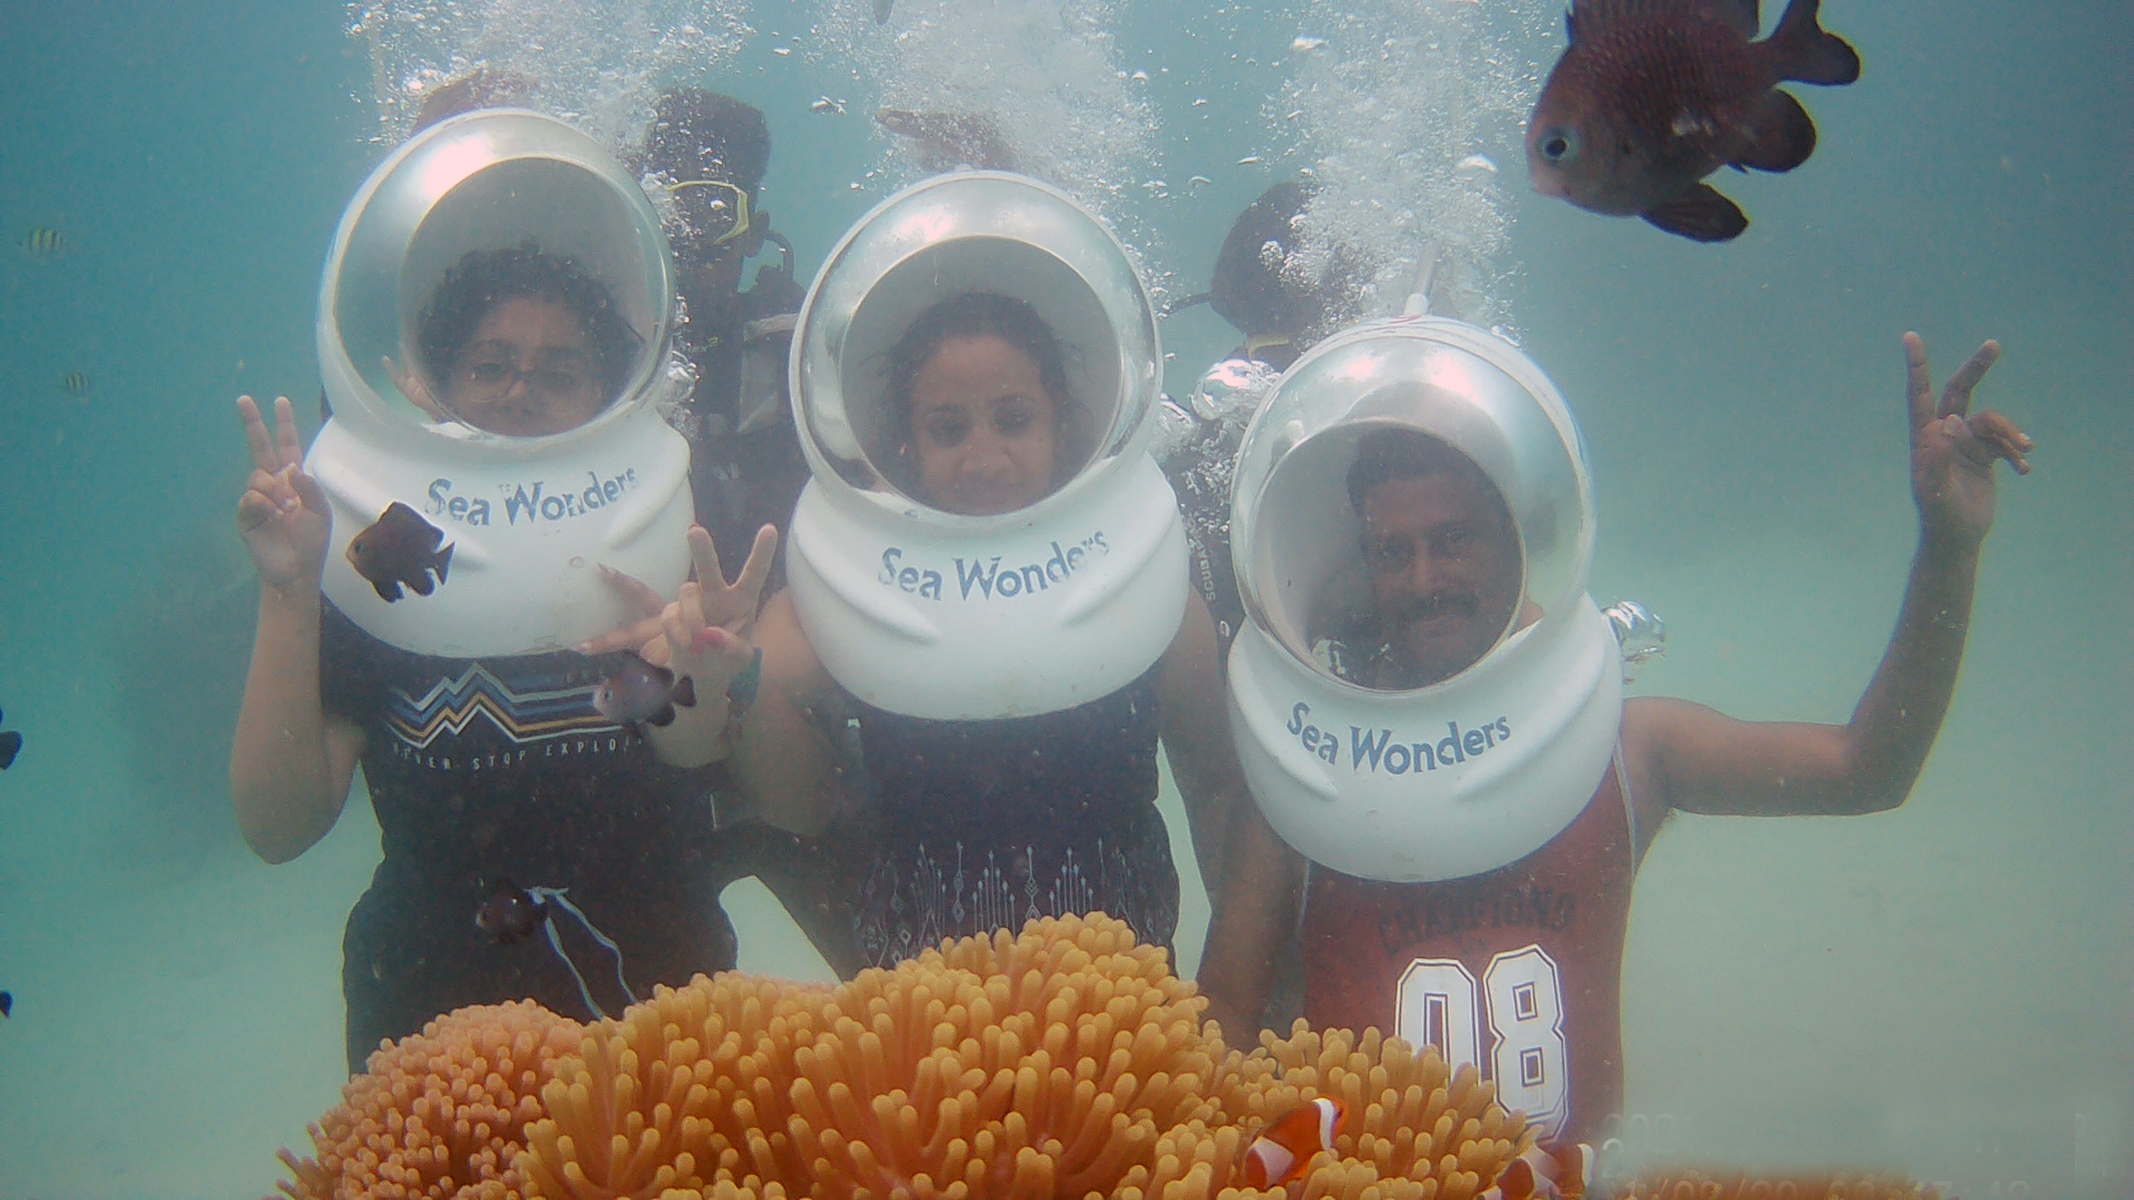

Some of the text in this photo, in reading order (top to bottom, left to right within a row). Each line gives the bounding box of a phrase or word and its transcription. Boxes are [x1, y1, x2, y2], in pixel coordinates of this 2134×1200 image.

[425, 467, 637, 526] Sea Wonders
[878, 530, 1110, 601] Sea Wonders
[472, 750, 526, 771] STOP
[546, 736, 642, 758] EXPLO
[1286, 701, 1511, 775] Sea Wonders
[1394, 943, 1568, 1141] 08
